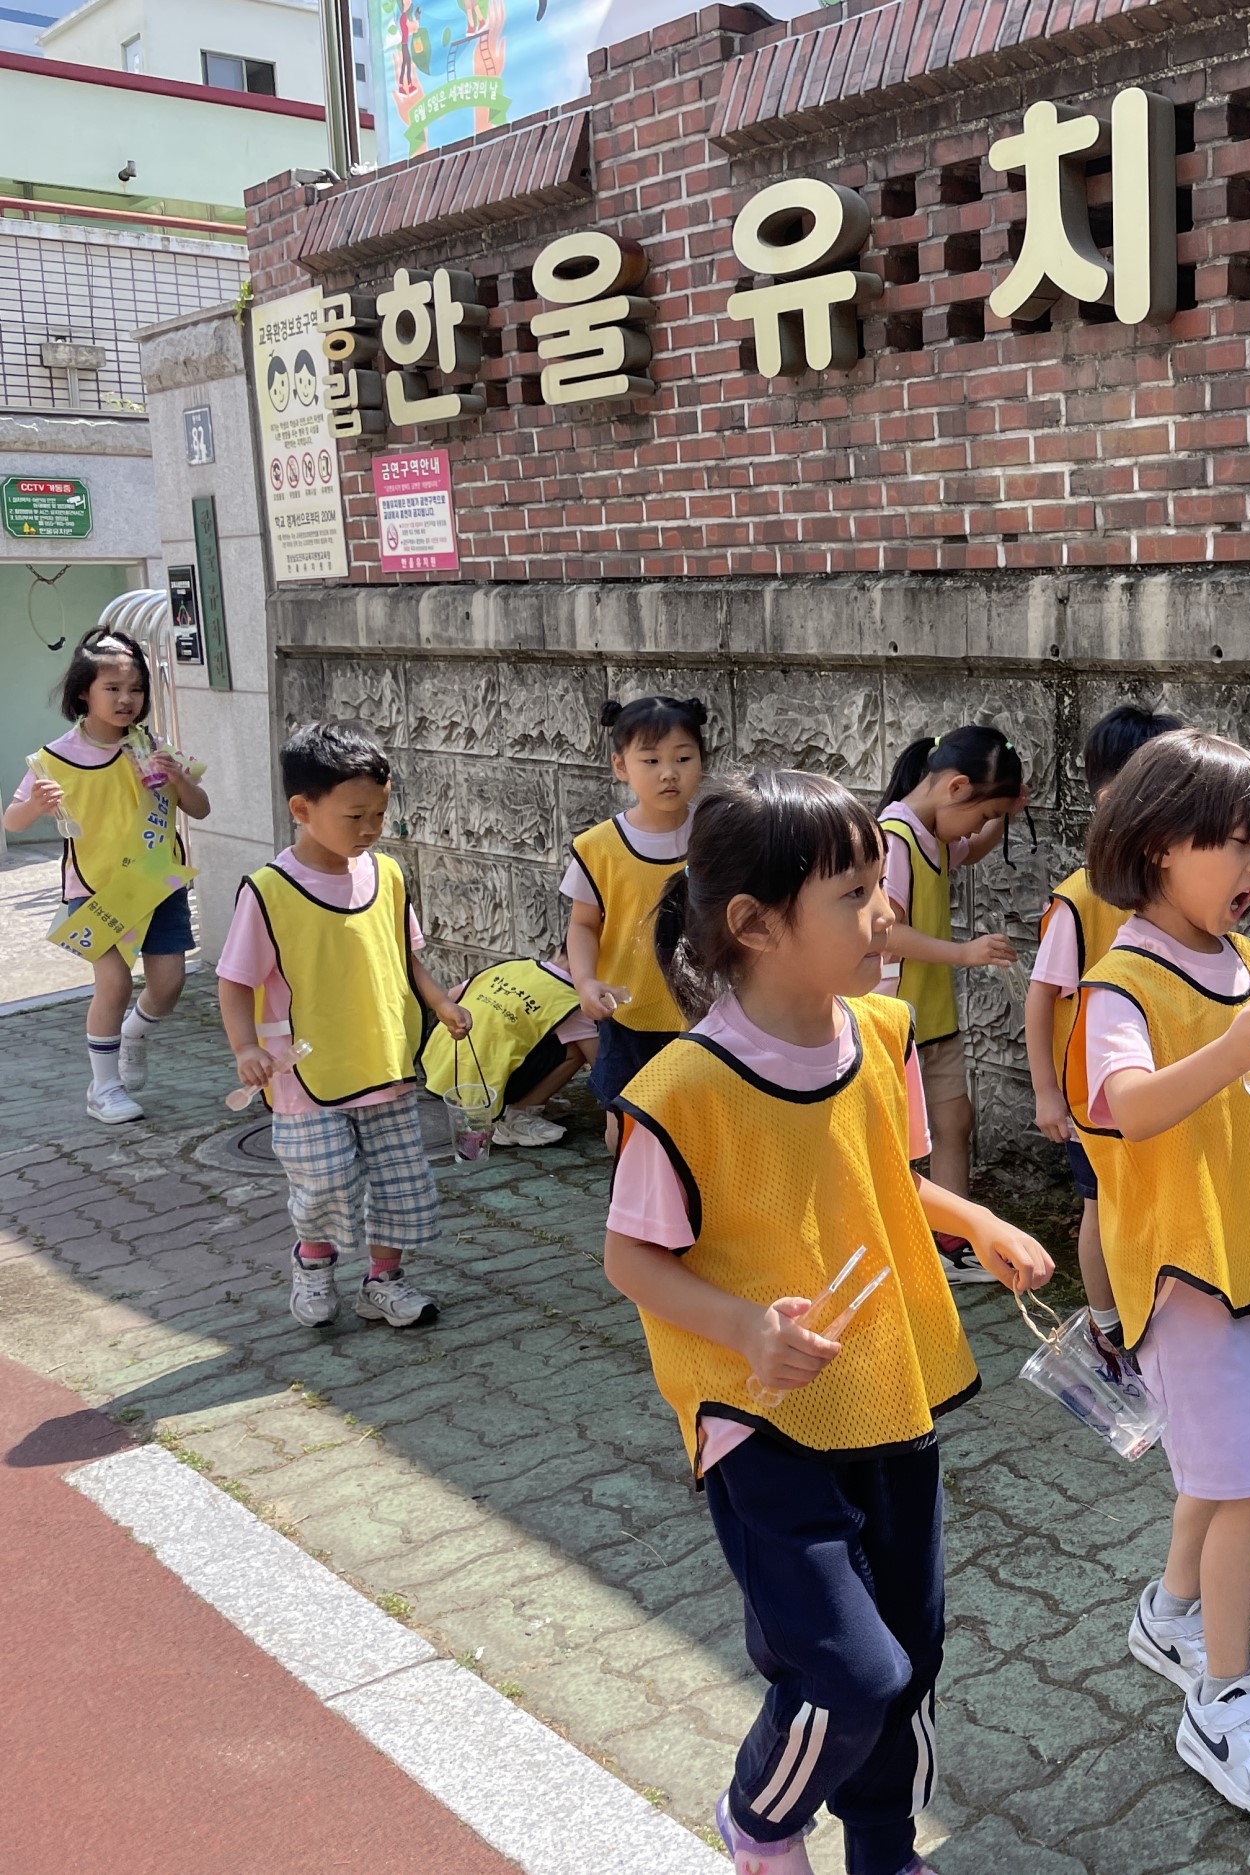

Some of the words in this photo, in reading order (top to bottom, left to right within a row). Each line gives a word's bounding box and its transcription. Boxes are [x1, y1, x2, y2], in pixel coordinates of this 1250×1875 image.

[414, 103, 426, 123] 6월
[427, 90, 447, 113] 5일은
[449, 81, 487, 102] 세계환경의
[489, 81, 499, 100] 날
[258, 310, 319, 345] 교육환경보호구역
[381, 456, 440, 481] 금연구역안내
[20, 483, 45, 492] CCTV
[274, 516, 285, 528] 학교
[286, 511, 320, 528] 경계선으로부터
[321, 509, 336, 522] 200M
[490, 976, 541, 1015] 한울유치원
